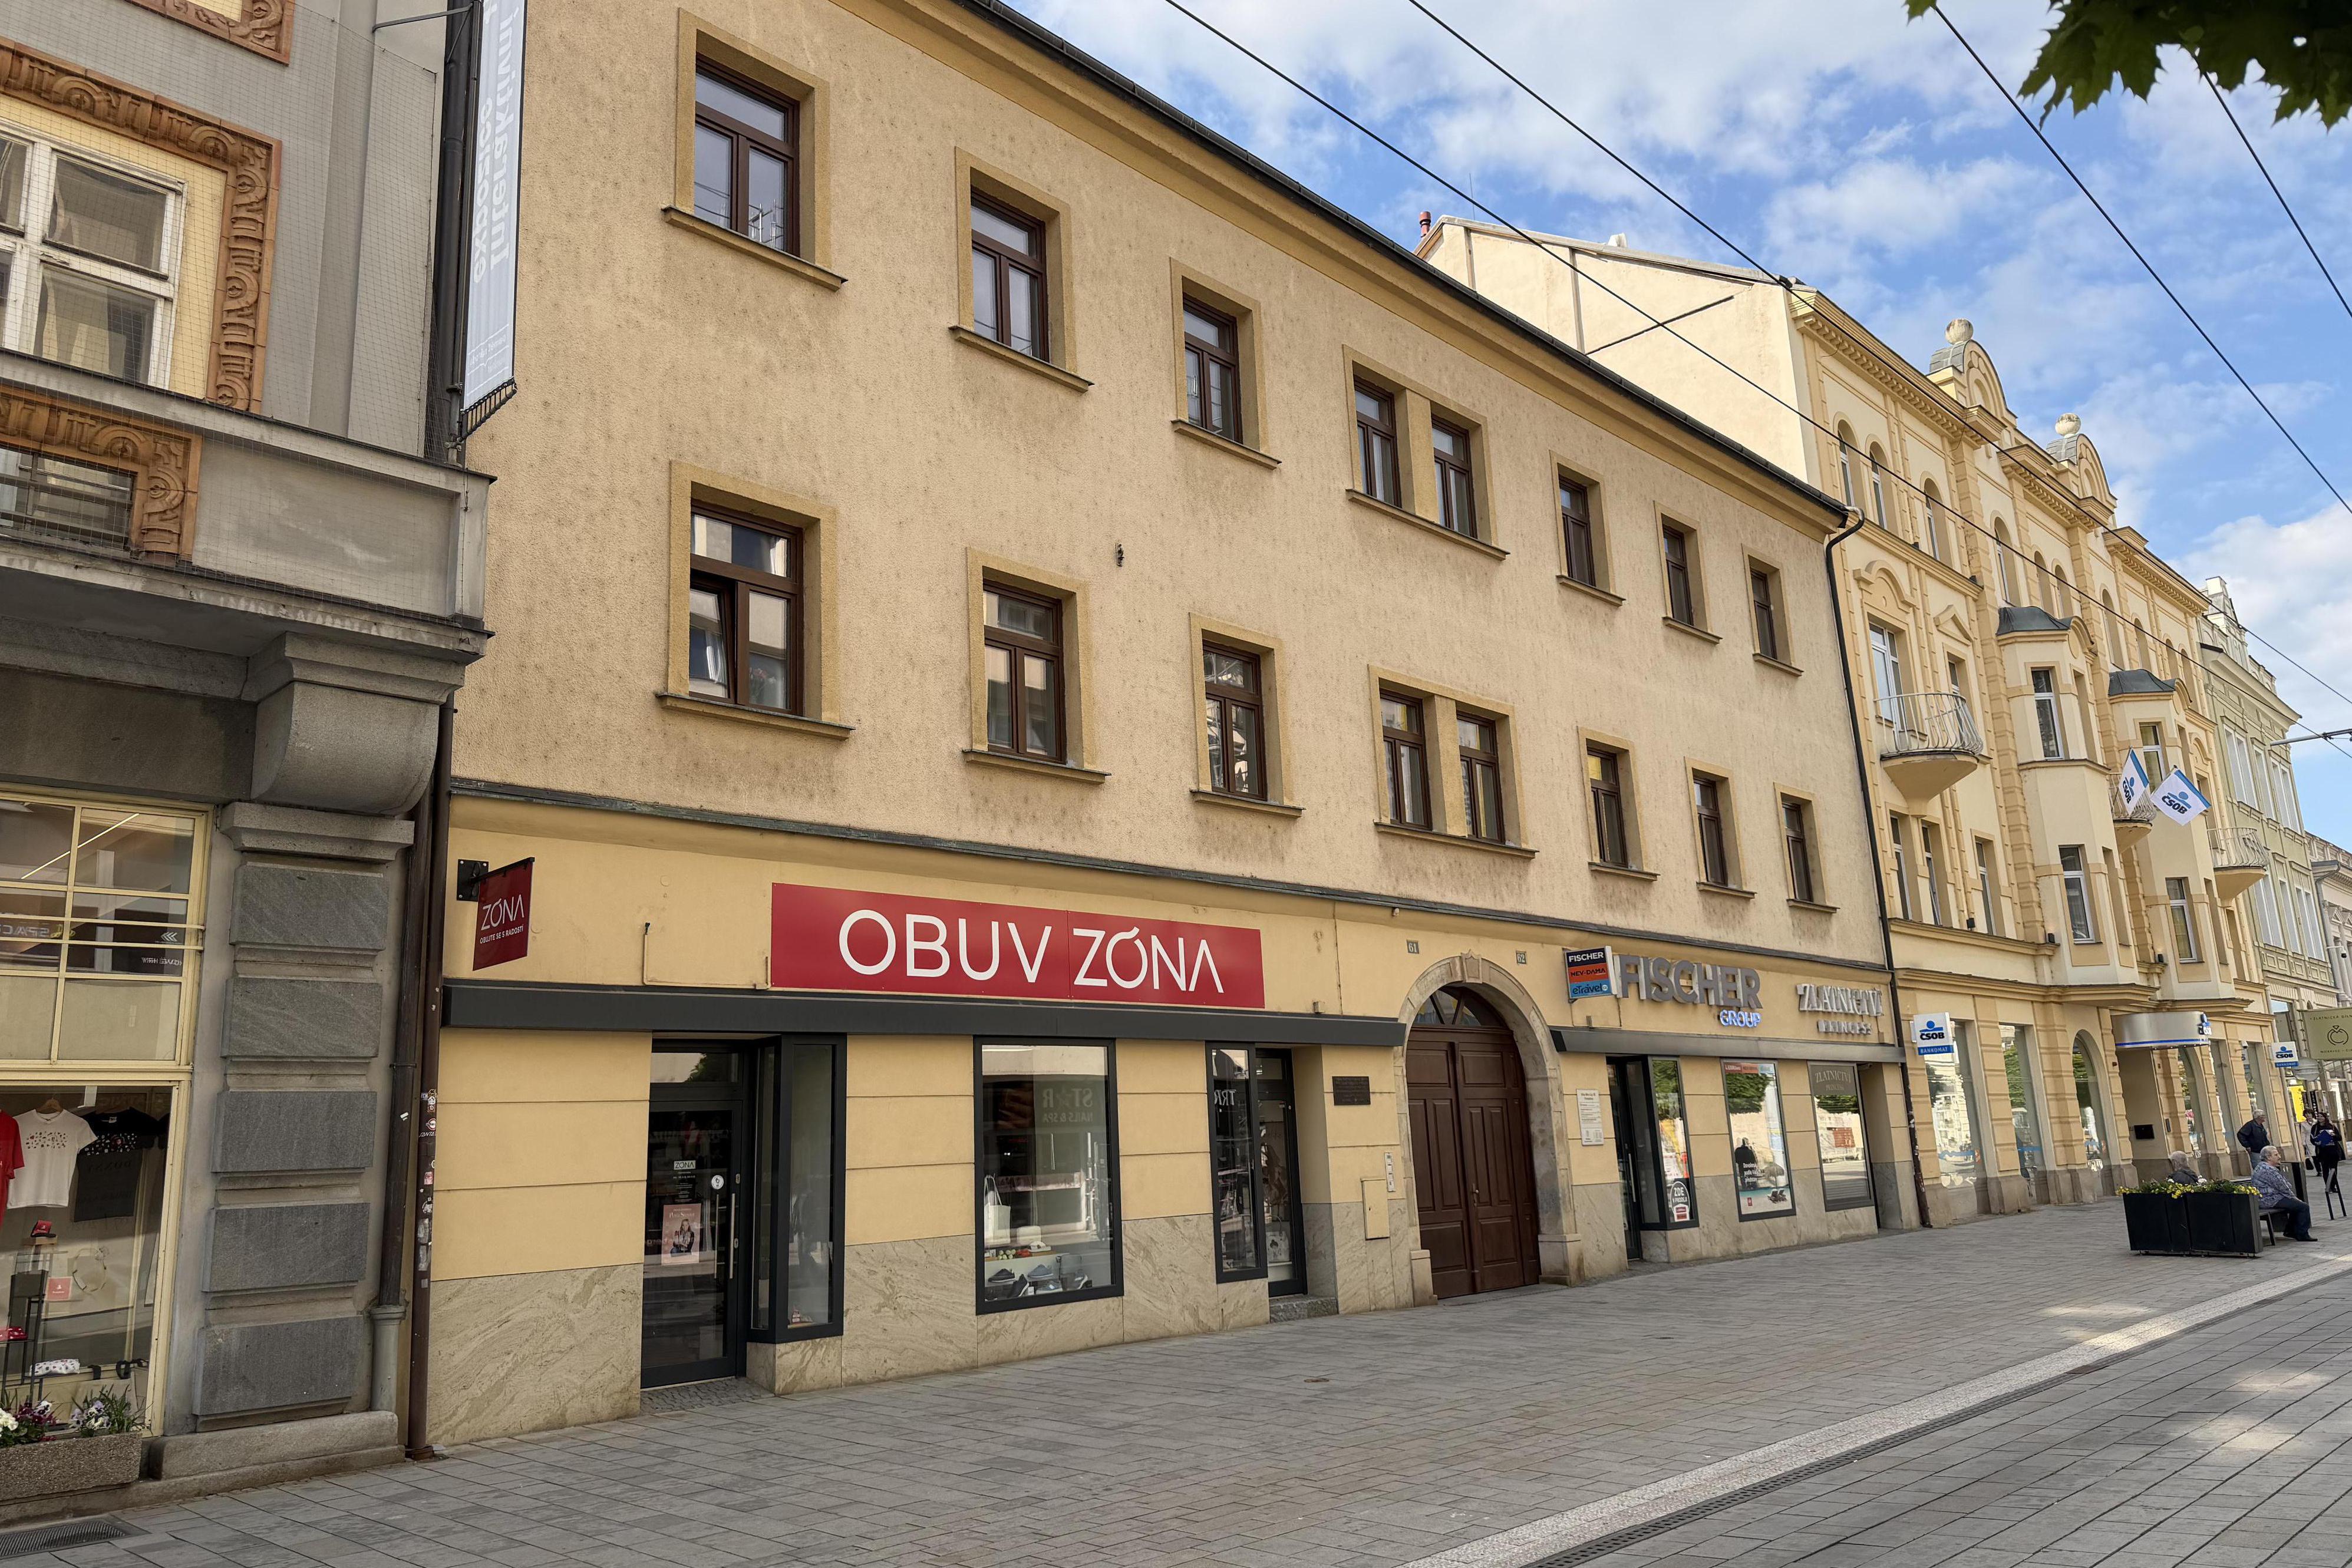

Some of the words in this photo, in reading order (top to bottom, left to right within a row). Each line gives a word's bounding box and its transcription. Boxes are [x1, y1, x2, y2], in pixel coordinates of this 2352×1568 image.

[2162, 795, 2188, 814] ČSOB
[481, 894, 525, 931] ZÓNA
[496, 932, 501, 940] SE
[506, 923, 524, 936] RADOSTÍ
[839, 909, 1052, 983] OBUV
[1073, 926, 1225, 993] ZÓNA
[1408, 943, 1417, 953] 61
[1518, 954, 1525, 962] 62
[1569, 952, 1604, 962] FISCHER
[1617, 954, 1763, 1008] FISCHER
[1719, 1009, 1761, 1028] GROUP
[1920, 1032, 1945, 1041] ČSOB
[1674, 1187, 1684, 1196] ZDE
